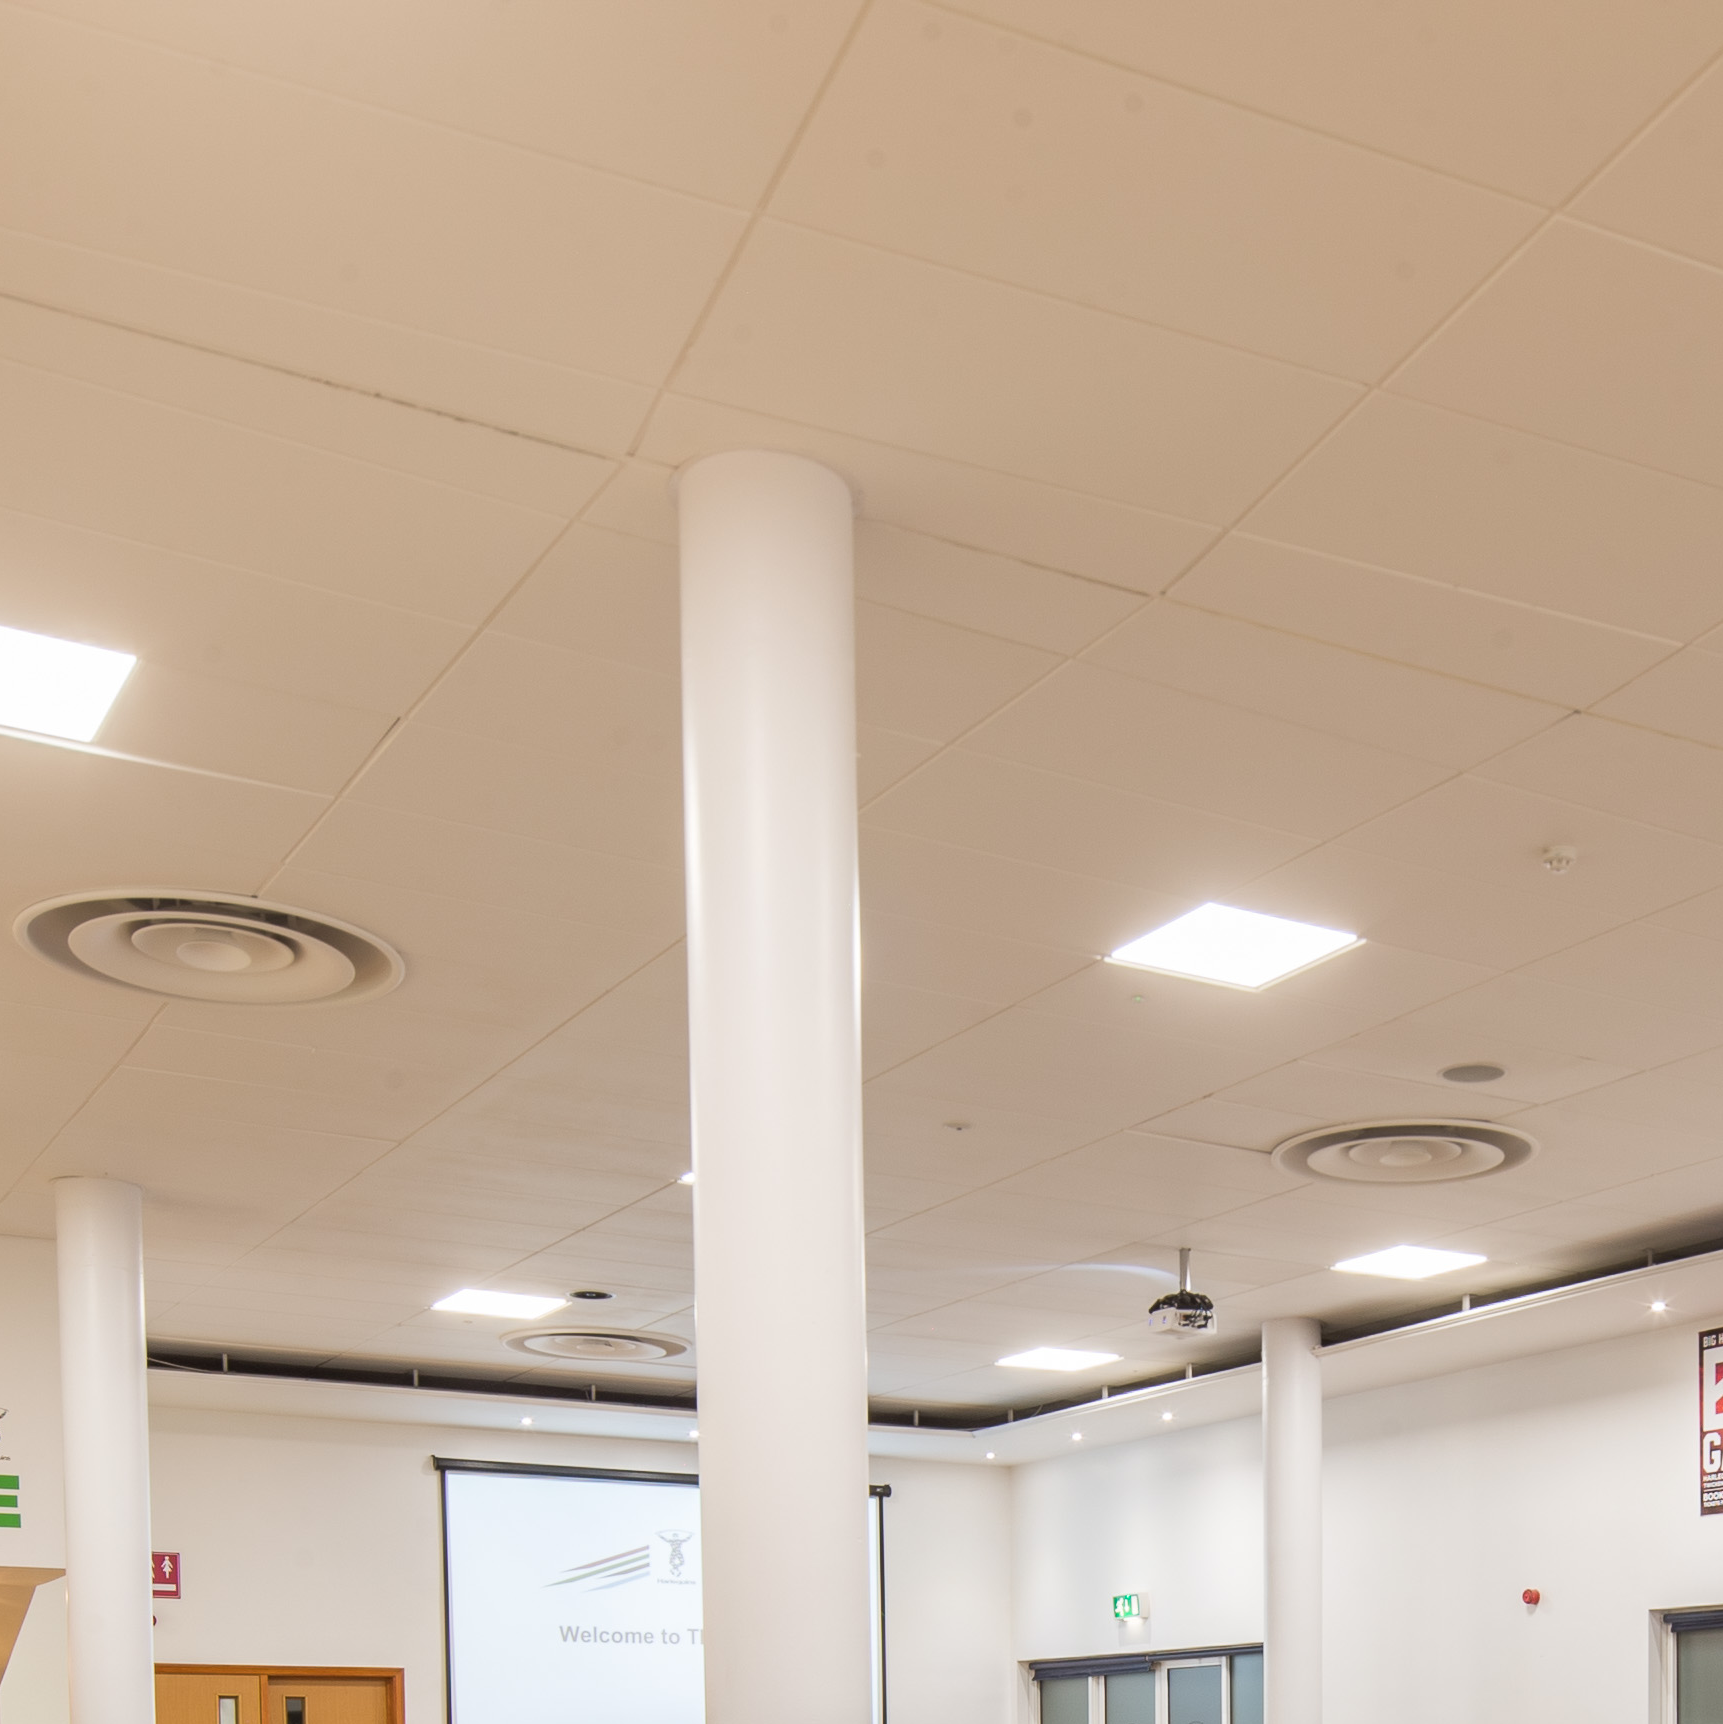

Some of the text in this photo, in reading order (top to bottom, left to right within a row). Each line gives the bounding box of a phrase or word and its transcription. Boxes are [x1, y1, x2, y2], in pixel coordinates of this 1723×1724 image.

[1703, 1335, 1716, 1347] BIG
[1703, 1491, 1723, 1501] BOOK
[559, 1625, 654, 1644] Welcome
[661, 1629, 680, 1645] to
